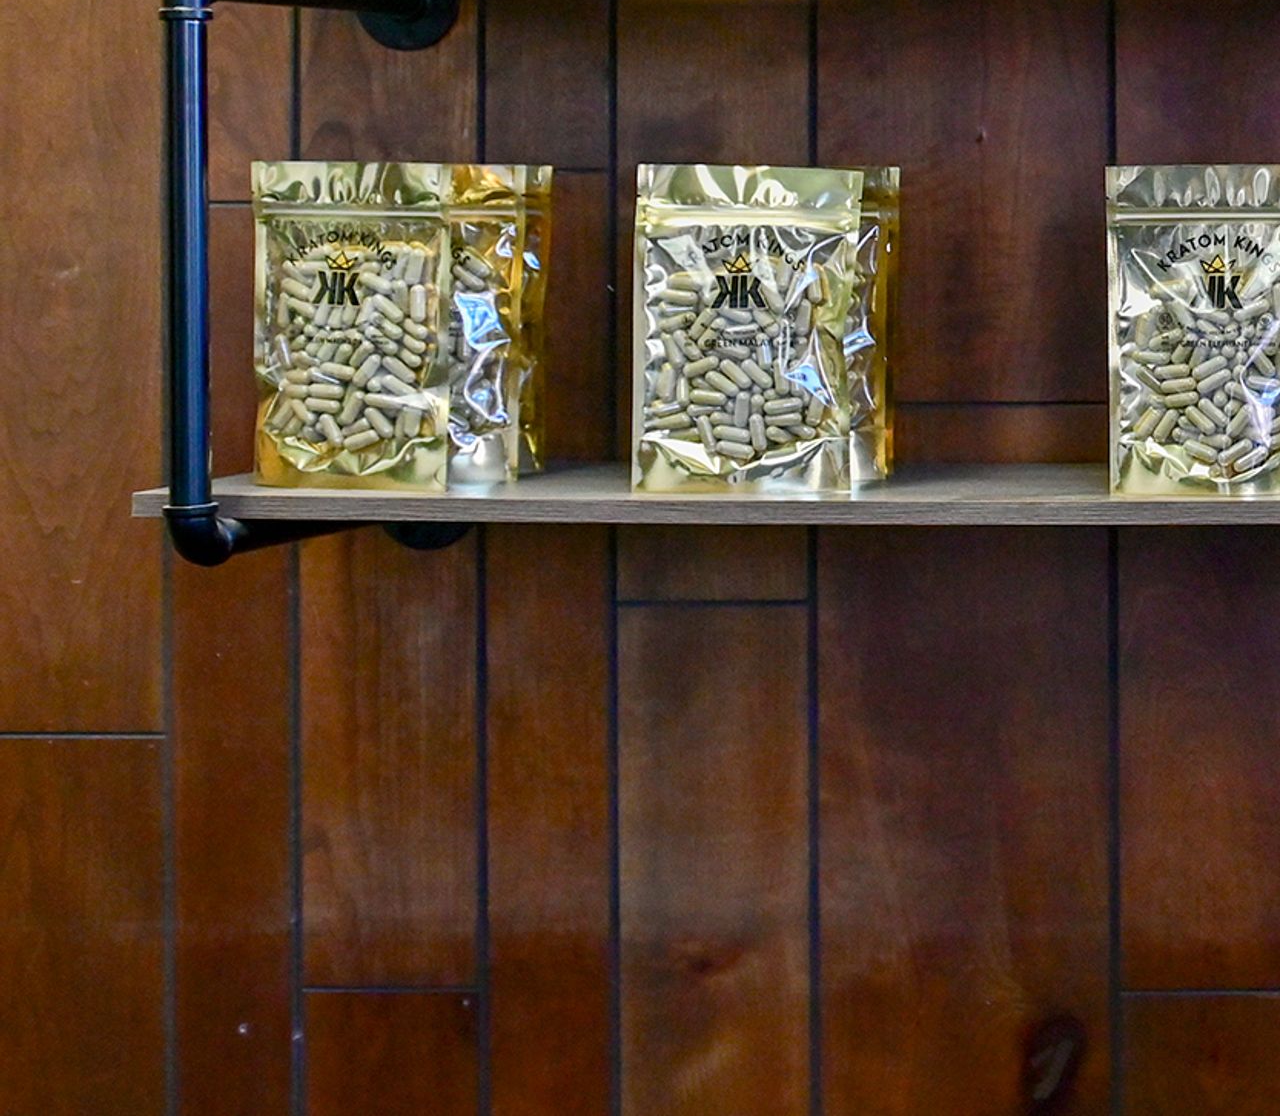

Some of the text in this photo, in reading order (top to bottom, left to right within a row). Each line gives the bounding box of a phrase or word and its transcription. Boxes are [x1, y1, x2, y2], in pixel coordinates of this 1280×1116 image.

[286, 230, 398, 271] KRATOM KINGS
[1156, 233, 1280, 274] KRATOM KINGS
